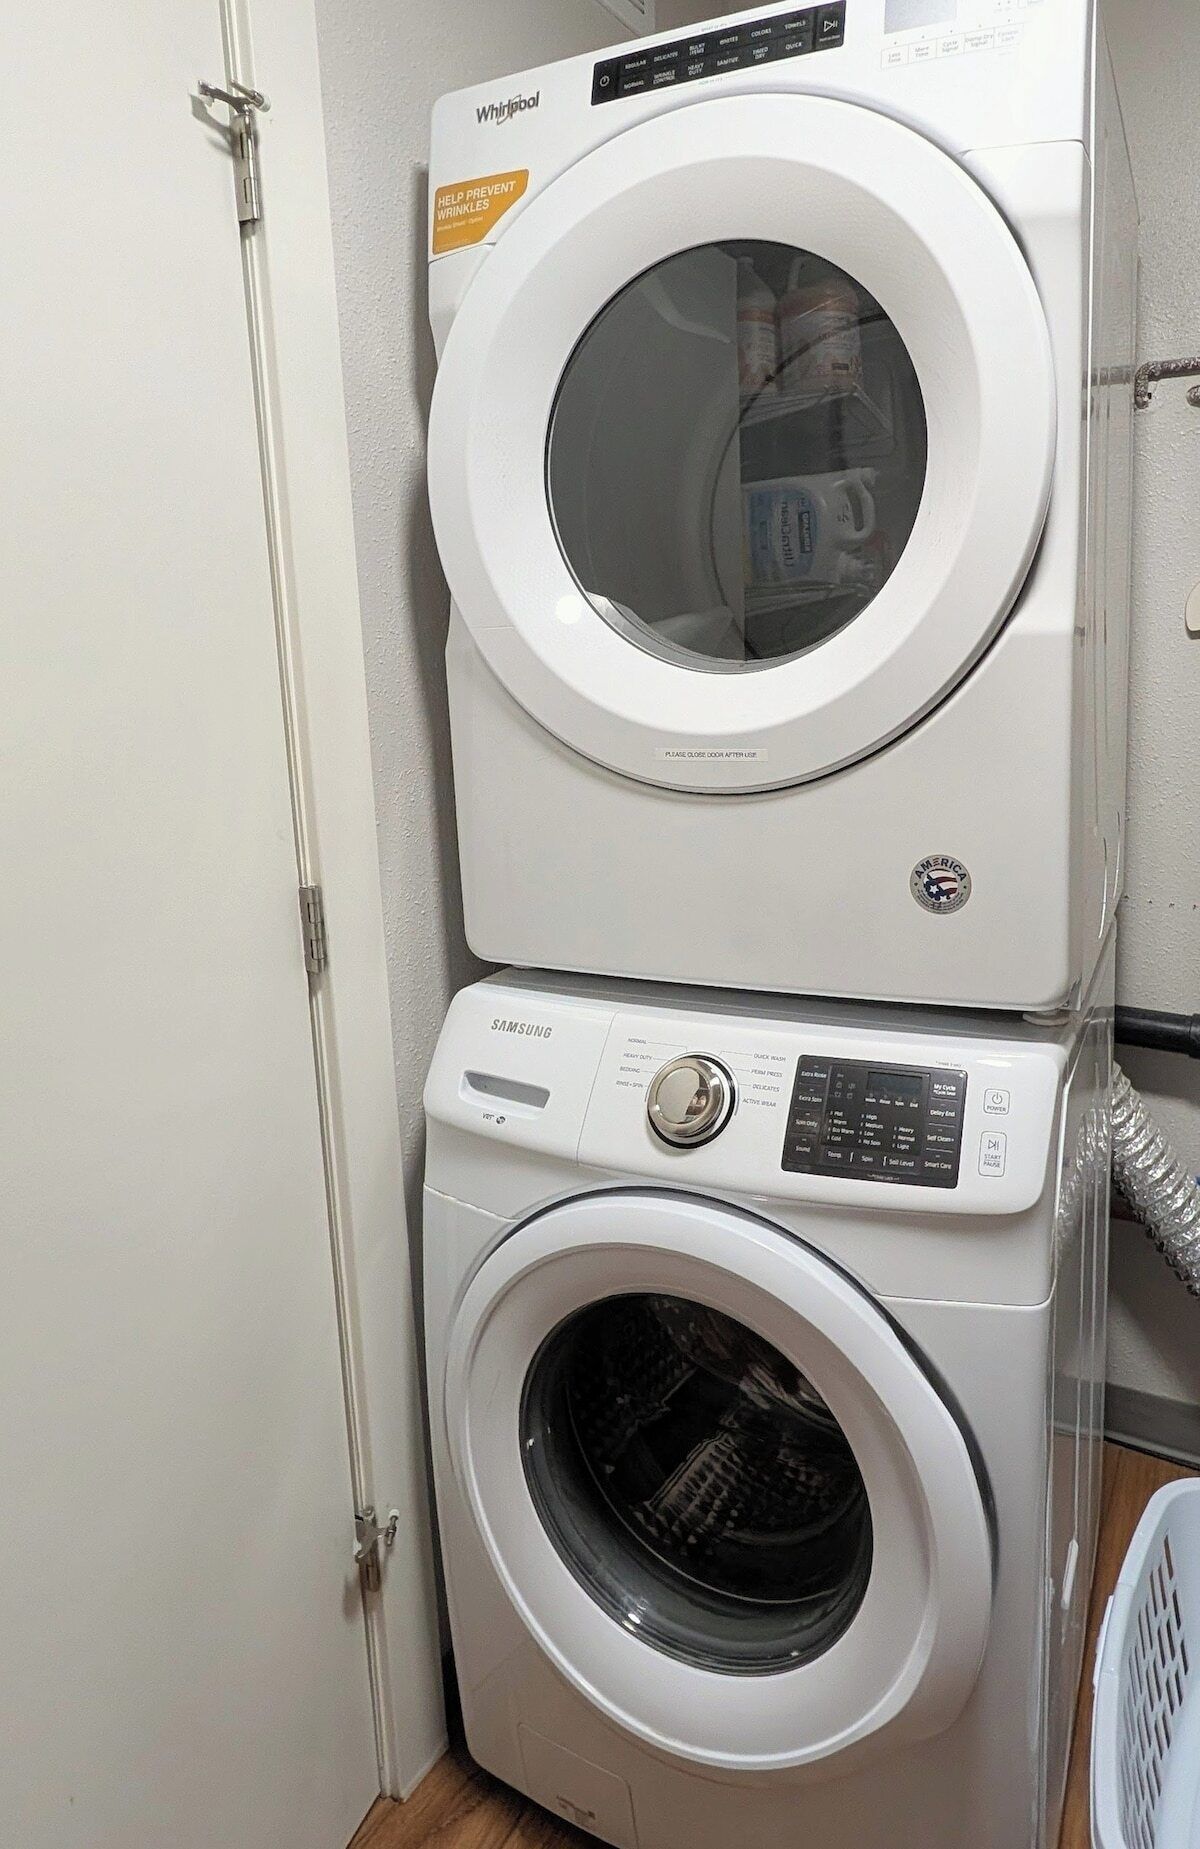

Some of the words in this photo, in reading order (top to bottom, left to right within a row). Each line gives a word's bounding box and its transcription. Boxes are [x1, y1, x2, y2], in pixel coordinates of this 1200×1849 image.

[751, 28, 772, 37] COLORS
[785, 42, 802, 50] QUICK
[624, 80, 644, 89] NORMAL
[476, 91, 540, 123] Whirlpool
[438, 192, 464, 208] HELP
[466, 180, 516, 199] PREVENT
[436, 198, 490, 221] WRINKLES
[915, 857, 967, 881] AMERICA
[491, 1019, 552, 1039] SAMSUNG
[623, 1052, 638, 1060] HEAVY
[752, 1083, 780, 1092] DELICATES
[742, 1098, 760, 1106] ACTIVE
[761, 1100, 777, 1108] WEAR
[806, 1120, 818, 1128] Only
